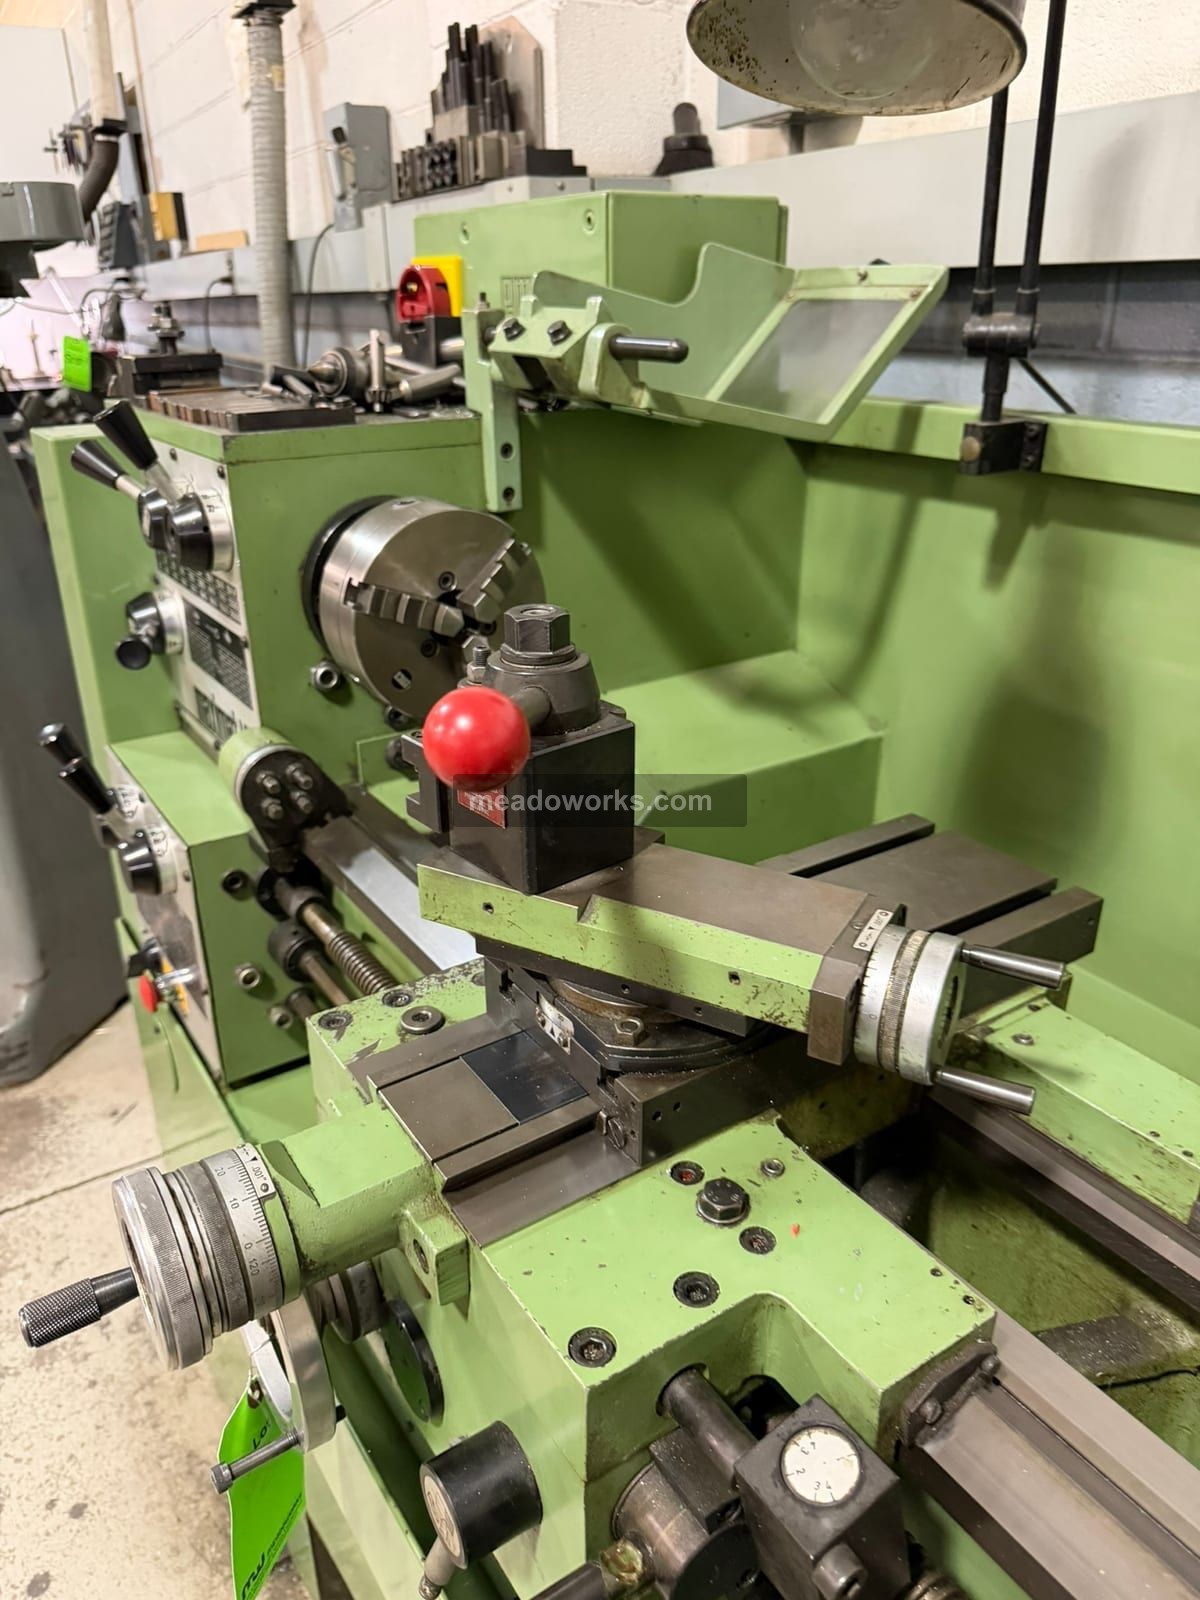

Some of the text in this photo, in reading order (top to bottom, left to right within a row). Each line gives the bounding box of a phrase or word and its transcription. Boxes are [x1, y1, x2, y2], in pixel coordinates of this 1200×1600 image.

[214, 1167, 226, 1177] 20
[229, 1198, 240, 1209] 10
[244, 1242, 253, 1250] 0
[248, 1258, 260, 1276] 120
[796, 1467, 806, 1475] 2
[814, 1481, 821, 1490] 3
